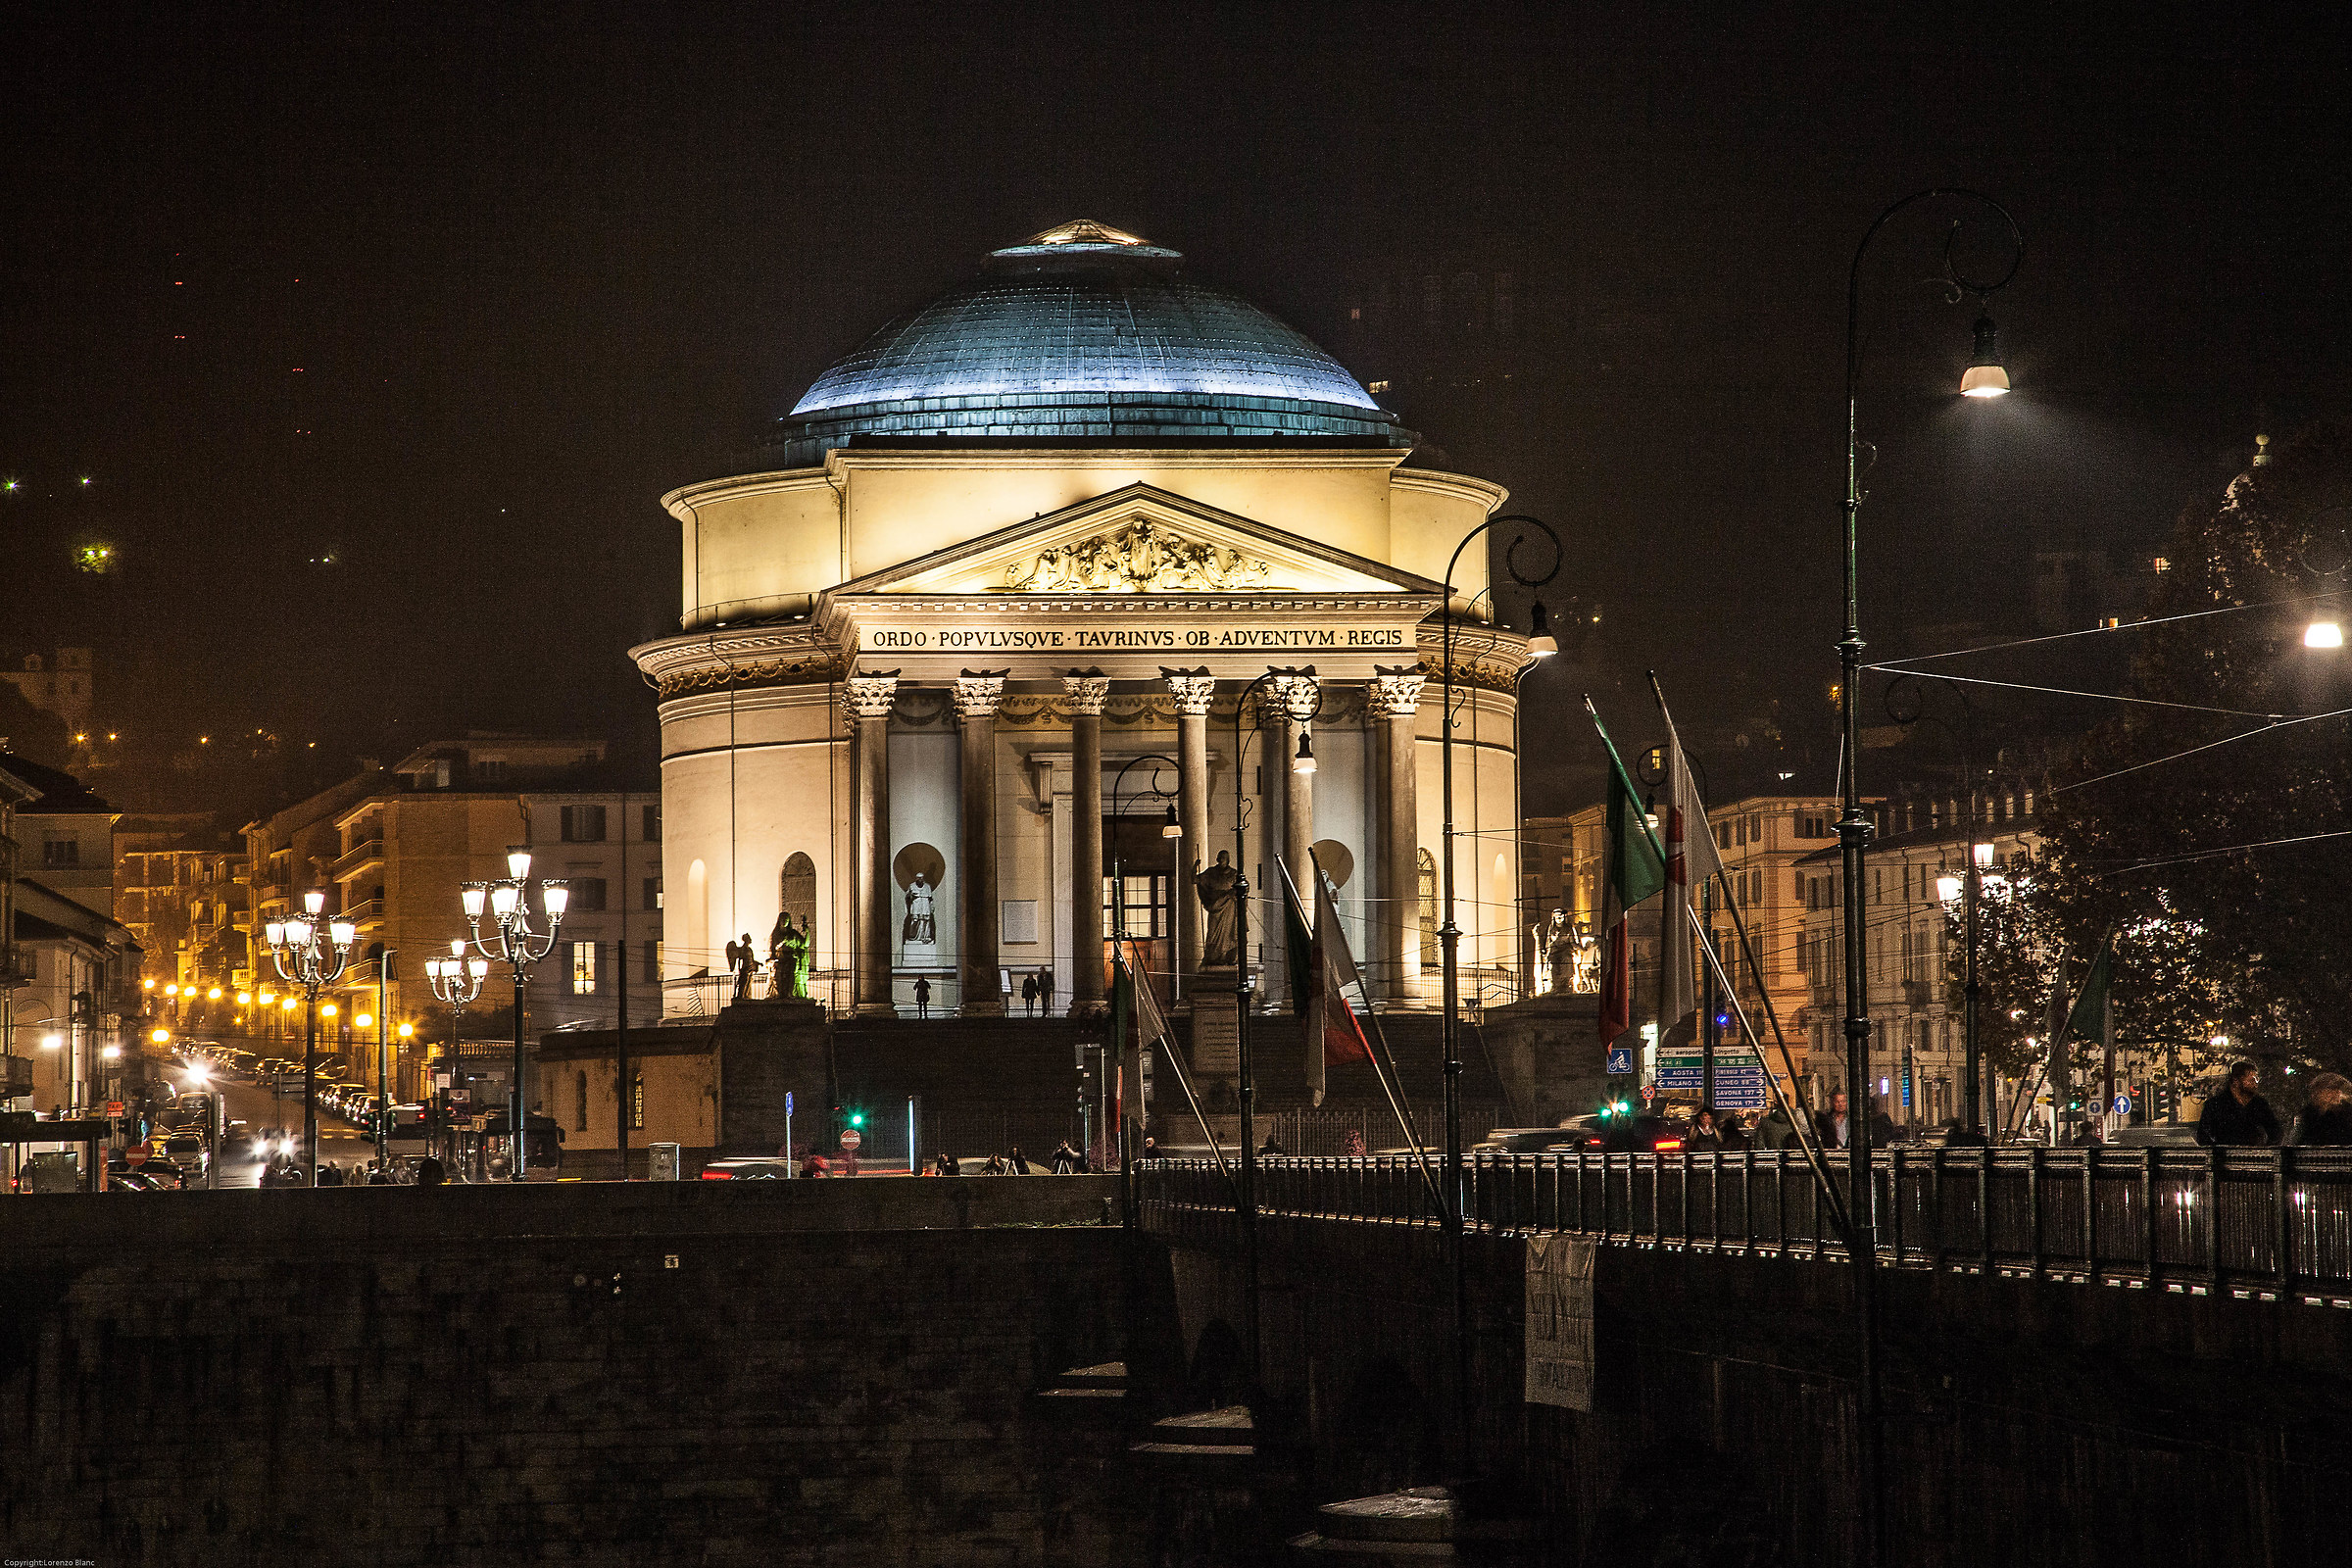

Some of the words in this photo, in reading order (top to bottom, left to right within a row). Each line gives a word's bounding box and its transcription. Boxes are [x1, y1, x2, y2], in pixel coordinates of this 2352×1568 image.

[873, 631, 927, 646] ORDO
[939, 631, 1063, 648] POPVLVSQVE
[1074, 630, 1174, 646] TAVRINVS
[1186, 630, 1210, 646] OB
[1219, 630, 1336, 646] ADVENTVM
[1347, 629, 1402, 645] REGIS
